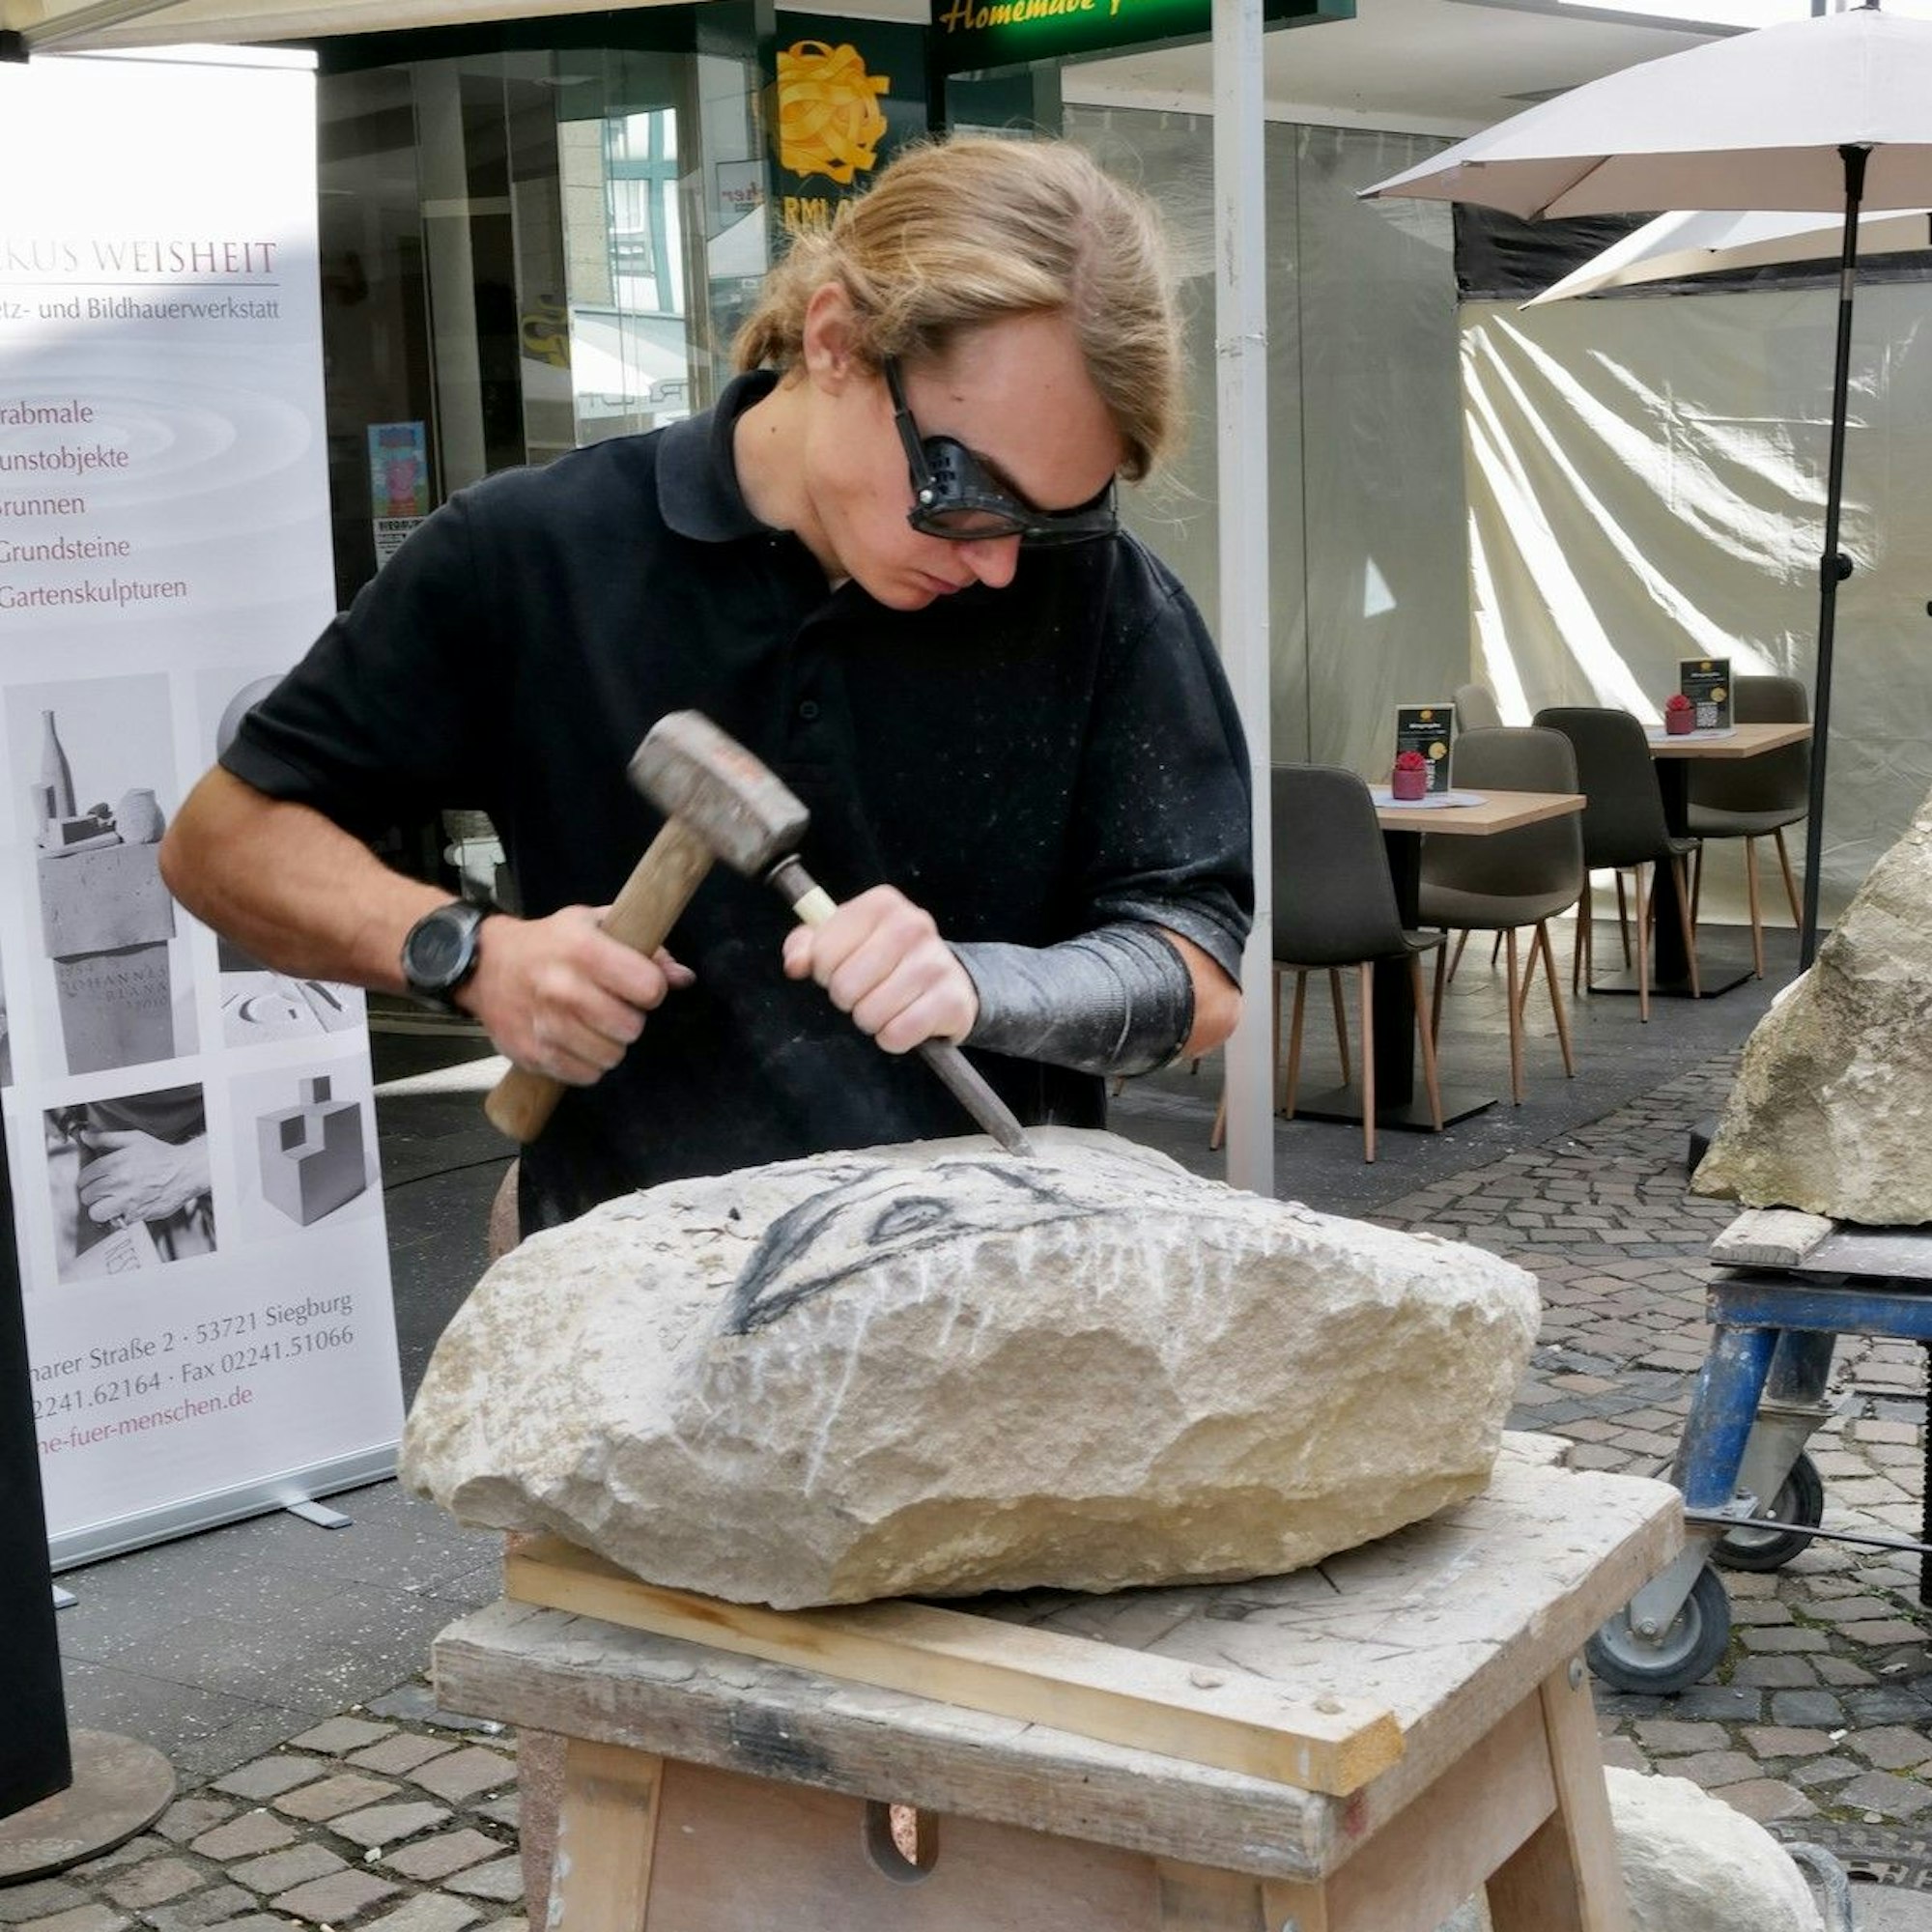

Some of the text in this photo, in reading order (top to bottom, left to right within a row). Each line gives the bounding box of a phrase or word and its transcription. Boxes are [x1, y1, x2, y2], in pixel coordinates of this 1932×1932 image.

[0, 240, 277, 273] KUS WEISHEIT
[0, 297, 281, 320] tz- und Bildhauerwerkstatt
[0, 400, 94, 425] rabmale
[0, 444, 129, 475] unstobjekte
[0, 497, 86, 517] runnen
[0, 578, 187, 609] Gartenskulpturen
[89, 1337, 156, 1370] Straße
[162, 1332, 174, 1352] 2
[195, 1312, 257, 1345] 53721
[266, 1294, 354, 1326] Siegburg
[181, 1359, 215, 1384] Fax
[221, 1324, 355, 1374] 02241.51066
